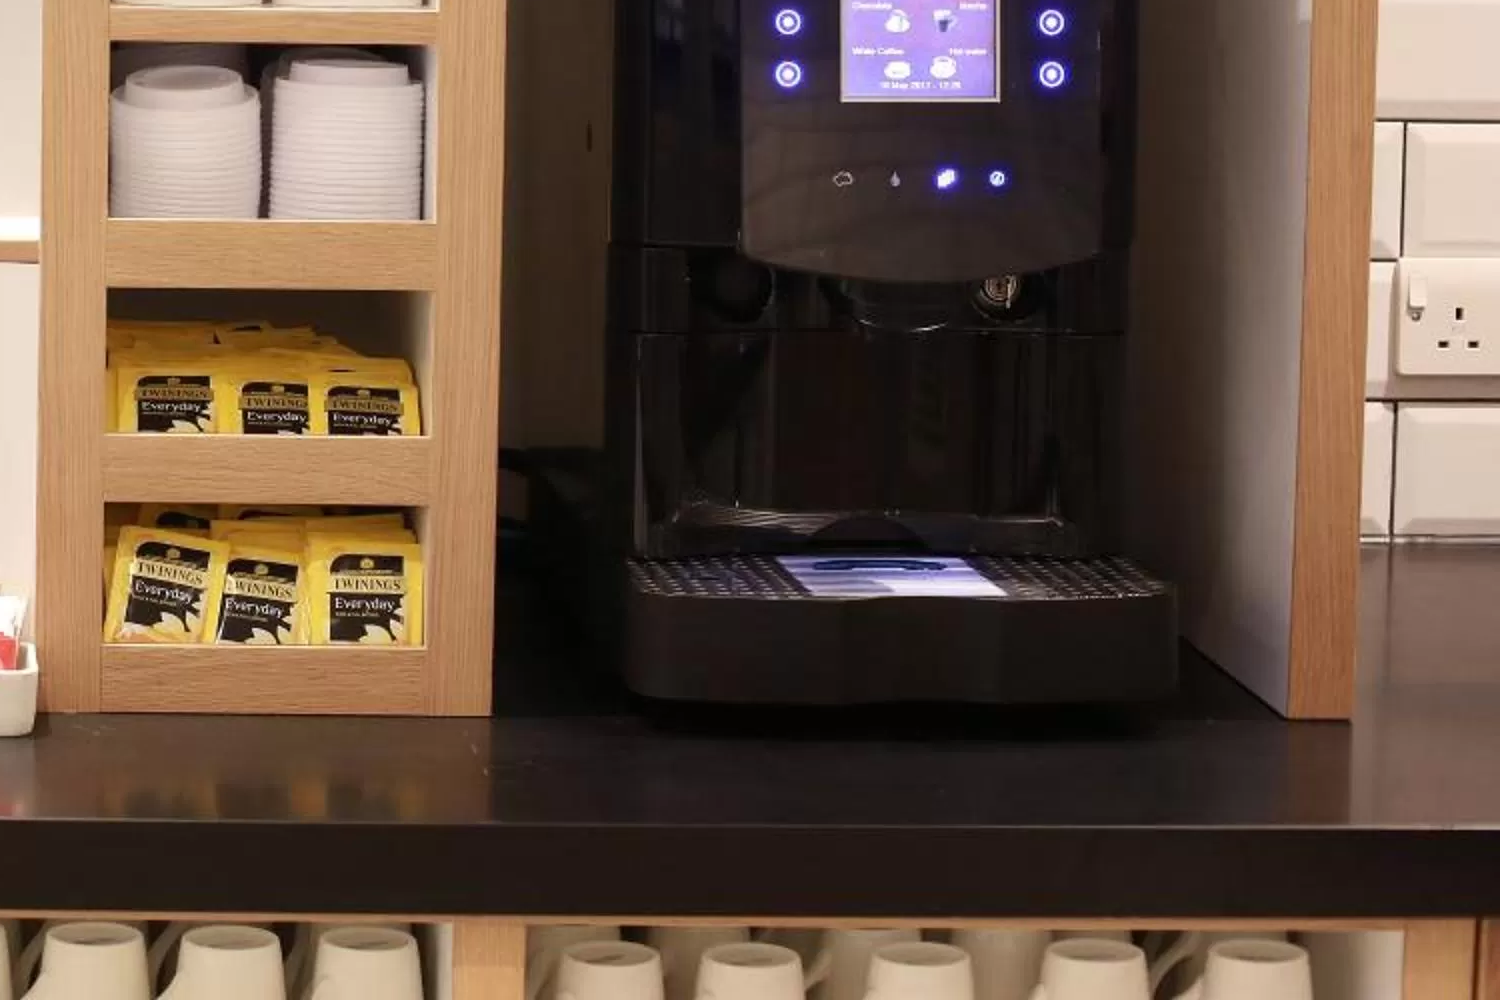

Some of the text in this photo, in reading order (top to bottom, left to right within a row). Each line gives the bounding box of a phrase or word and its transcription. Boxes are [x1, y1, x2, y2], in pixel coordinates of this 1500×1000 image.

[141, 401, 201, 413] Everyday
[247, 411, 306, 423] Everyday
[332, 413, 391, 427] Everyday
[139, 562, 203, 584] TWININGS
[333, 578, 401, 590] TWININGS
[135, 580, 193, 604] Everyday
[225, 597, 283, 619] Everyday
[335, 597, 396, 613] Everyday
